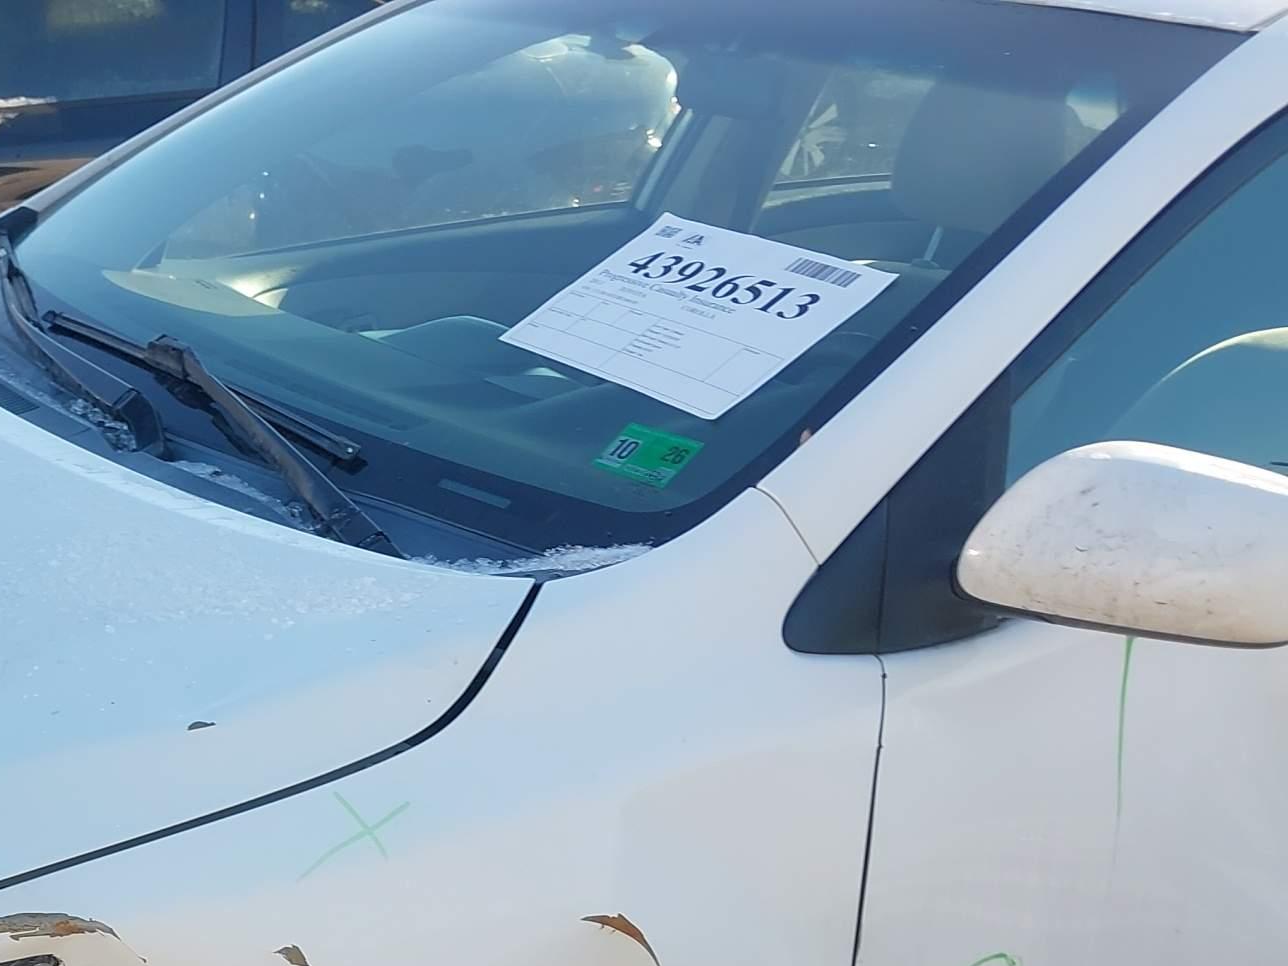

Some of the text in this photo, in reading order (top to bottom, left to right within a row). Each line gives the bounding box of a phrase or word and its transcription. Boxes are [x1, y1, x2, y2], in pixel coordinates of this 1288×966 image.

[599, 269, 649, 289] Progressive
[690, 294, 737, 314] Insurance
[628, 251, 821, 321] 43926513
[608, 438, 641, 460] 10
